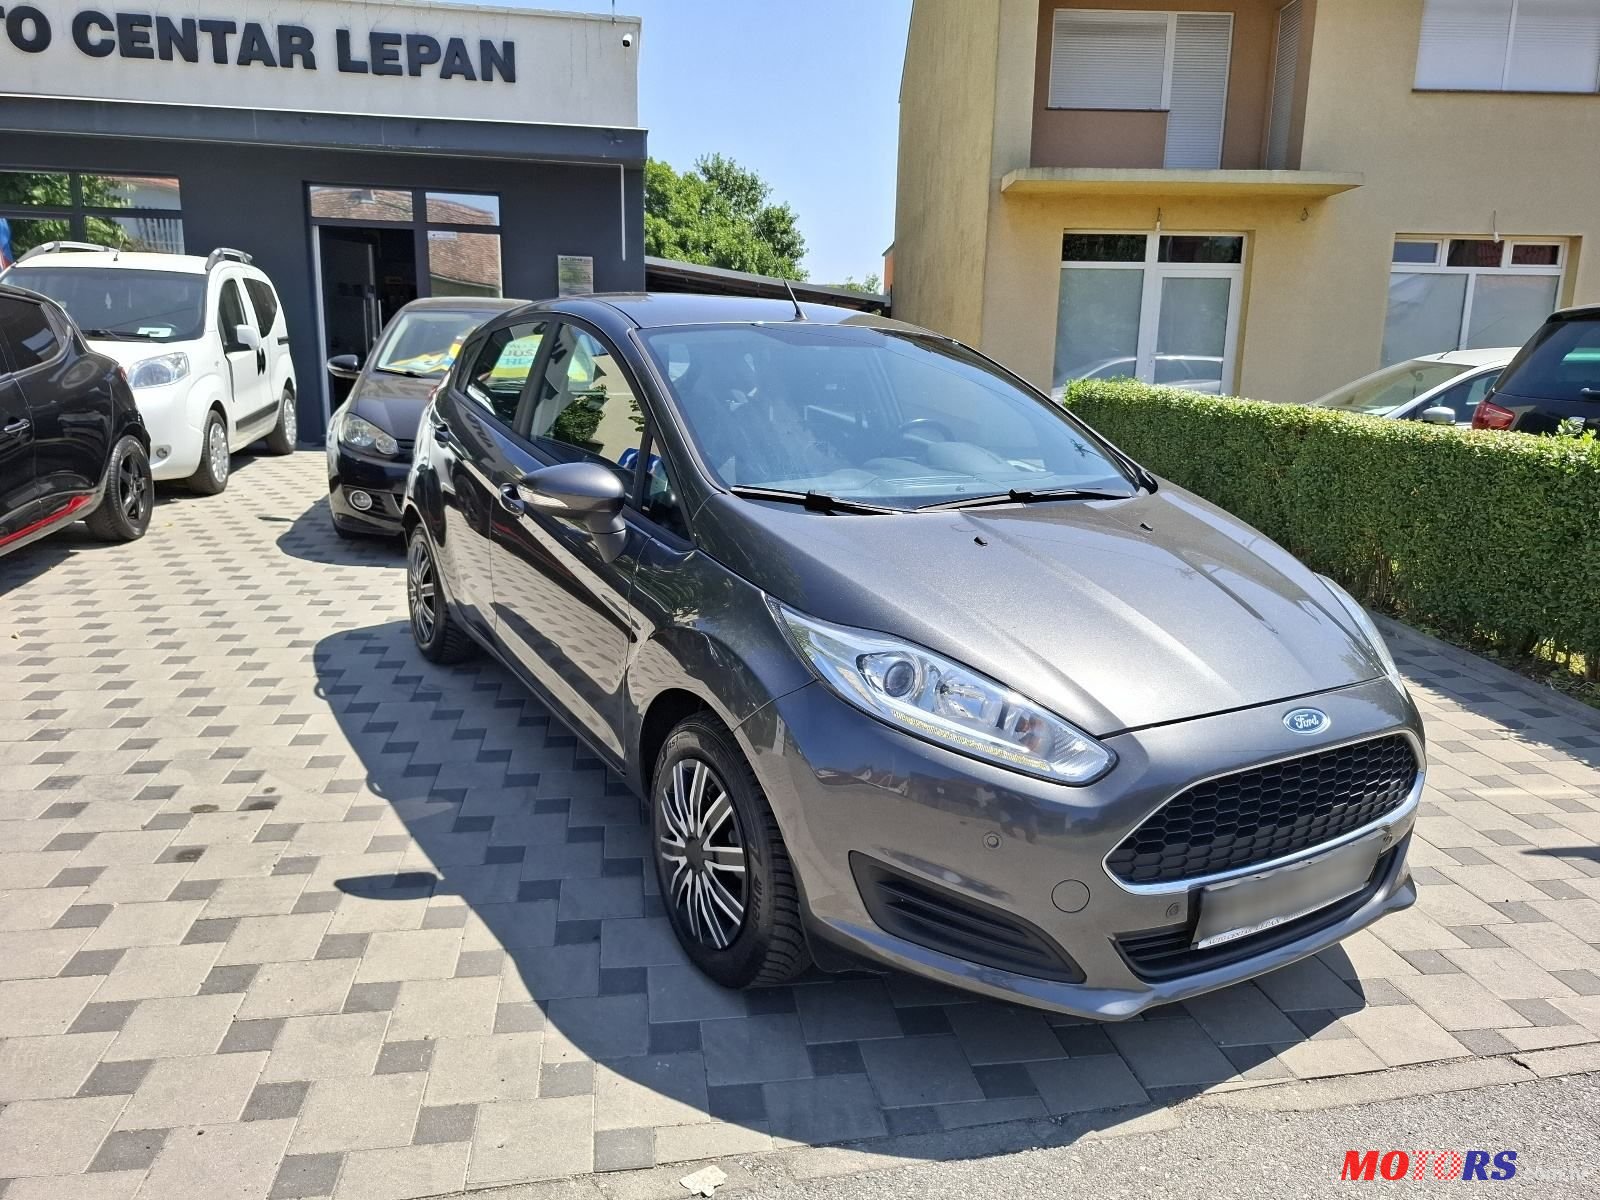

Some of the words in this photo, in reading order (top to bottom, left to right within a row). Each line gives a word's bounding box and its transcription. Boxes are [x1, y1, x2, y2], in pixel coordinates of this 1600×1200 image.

[71, 10, 318, 71] CENTAR
[335, 28, 517, 84] LEPAN
[1294, 713, 1319, 729] Ford
